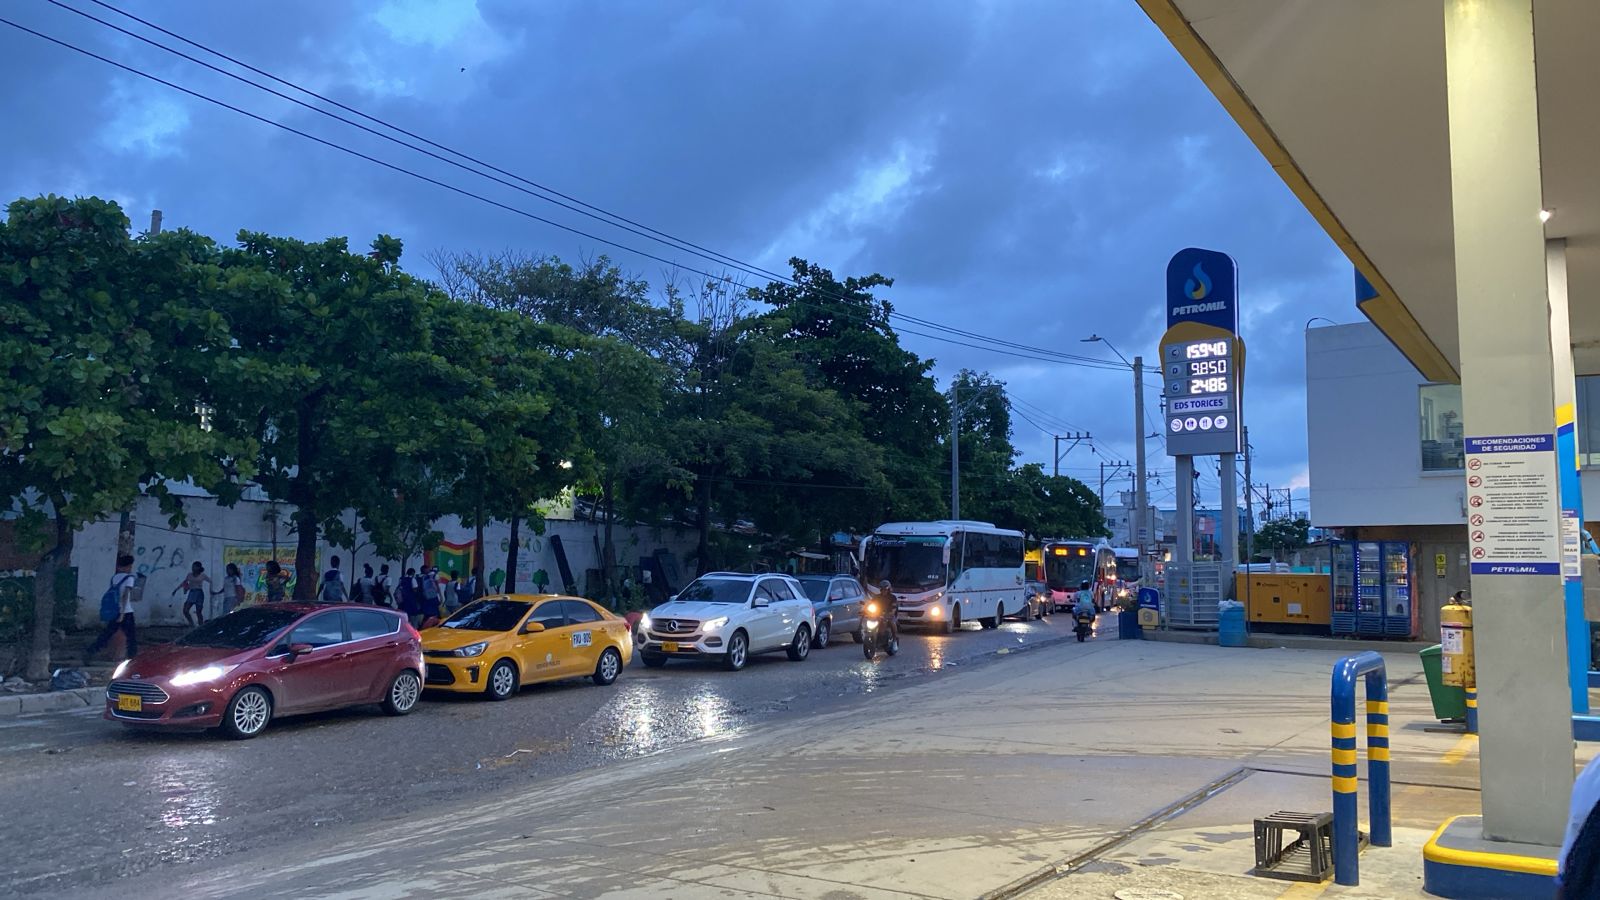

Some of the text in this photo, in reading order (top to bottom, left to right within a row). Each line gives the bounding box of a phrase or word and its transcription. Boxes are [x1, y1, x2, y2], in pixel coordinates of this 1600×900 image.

[1172, 301, 1227, 316] PETROMIL
[1174, 399, 1224, 410] EDS TORICES
[1472, 437, 1546, 446] RECOMENDACIONES
[1493, 444, 1537, 452] SEGURIDAD
